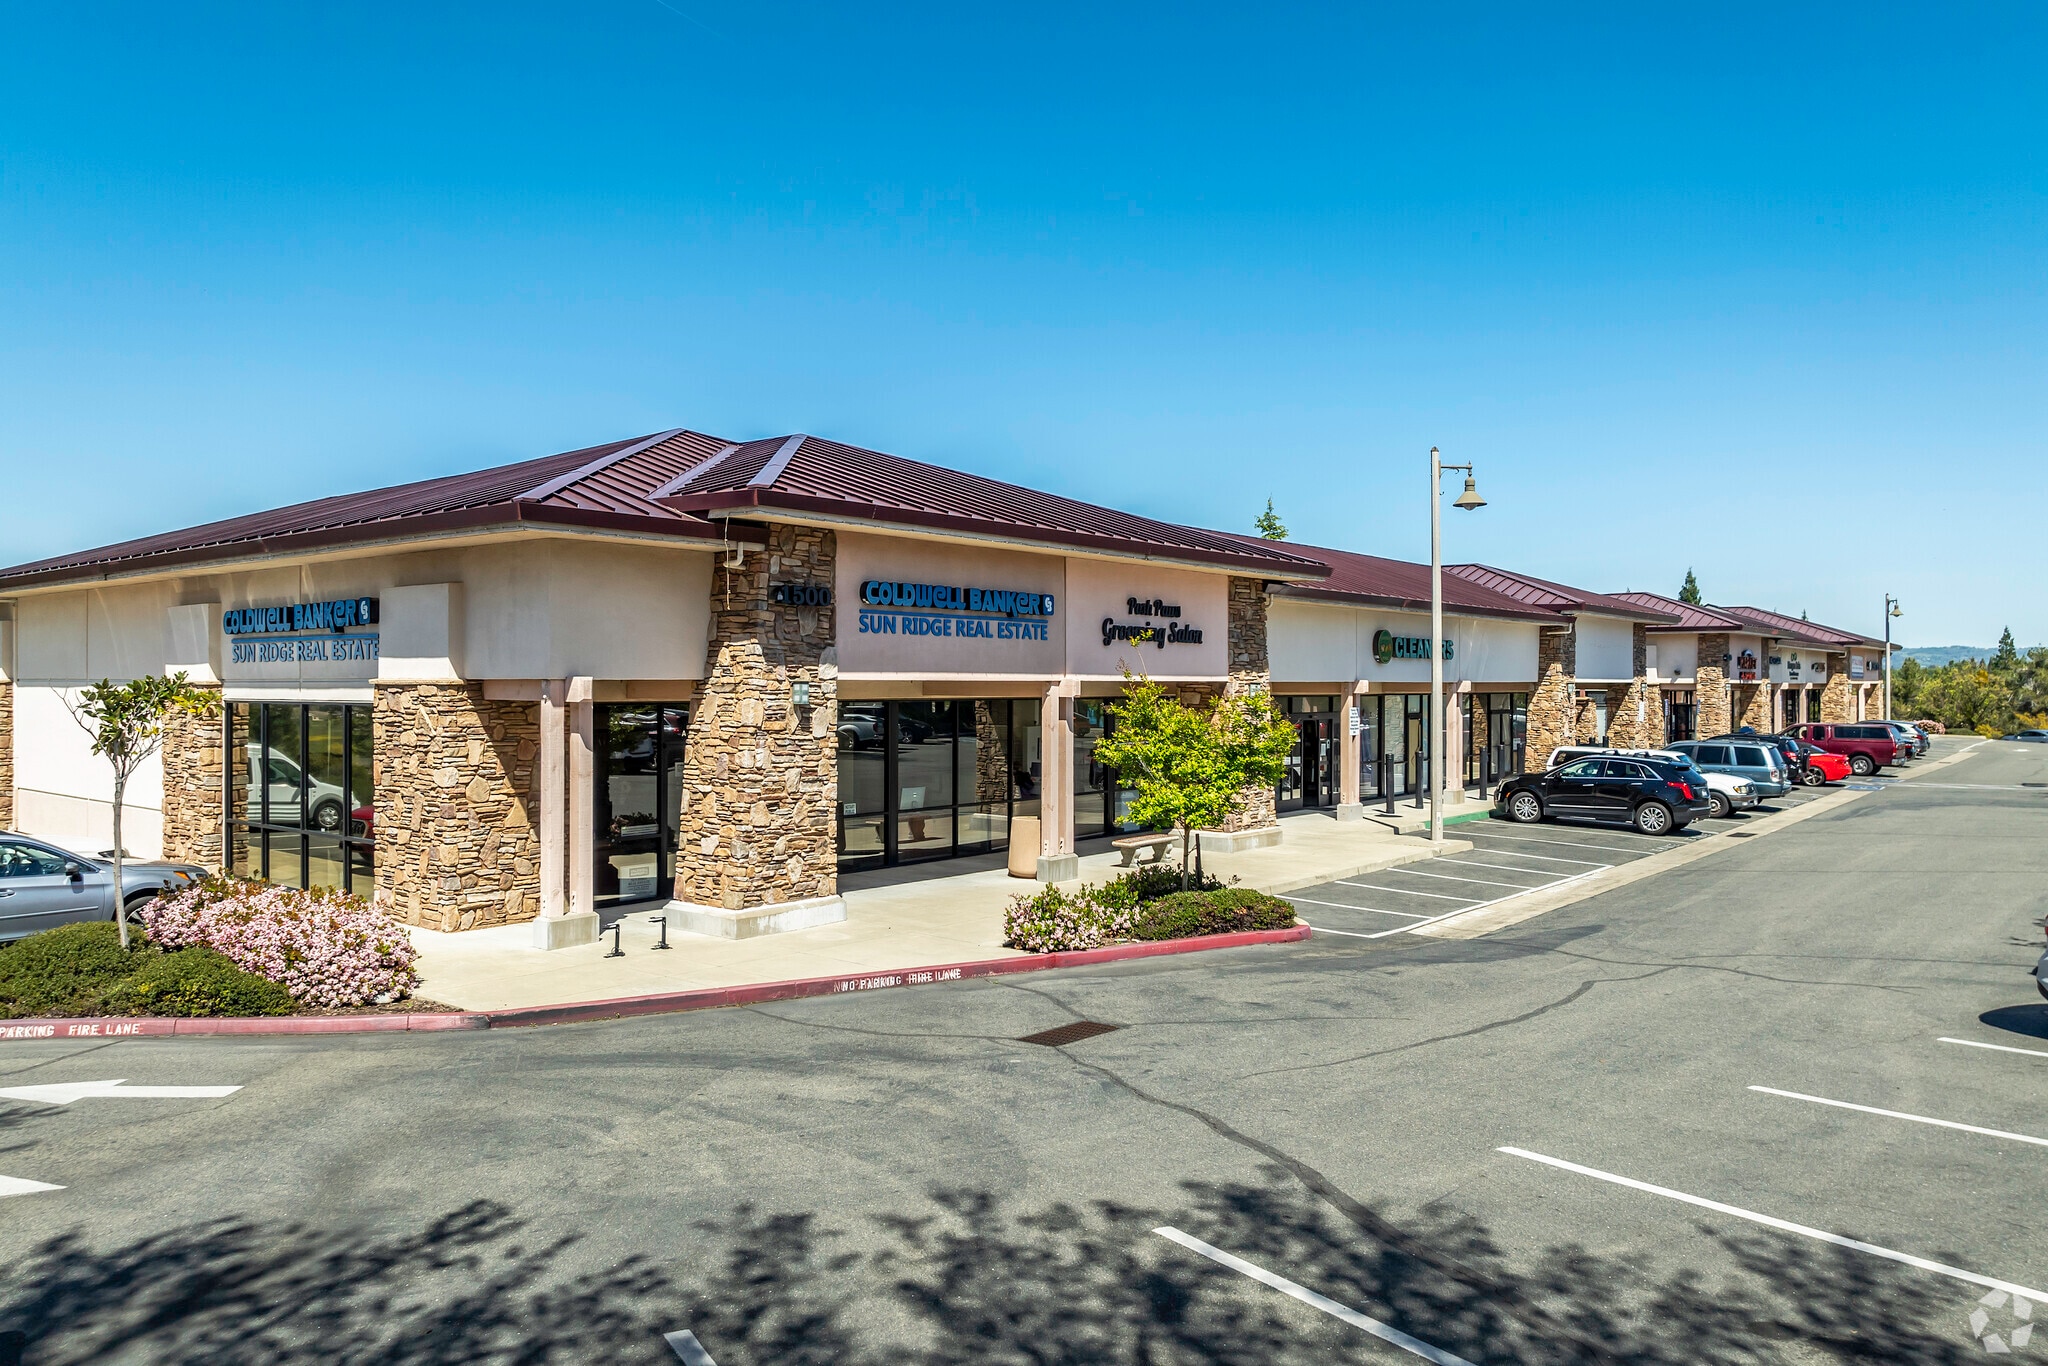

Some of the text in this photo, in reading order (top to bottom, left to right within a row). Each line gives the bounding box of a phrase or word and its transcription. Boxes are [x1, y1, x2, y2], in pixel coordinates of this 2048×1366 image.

[782, 584, 832, 607] 1500
[859, 614, 1049, 641] SUN RIDGE REAL ESTATE
[1167, 622, 1204, 645] Salon
[232, 639, 379, 663] SUN RIDGE REAL ESTATE
[1395, 636, 1455, 660] CLEANRS
[859, 976, 902, 990] PARKING
[0, 1023, 142, 1038] PARKING FIRE LANE
